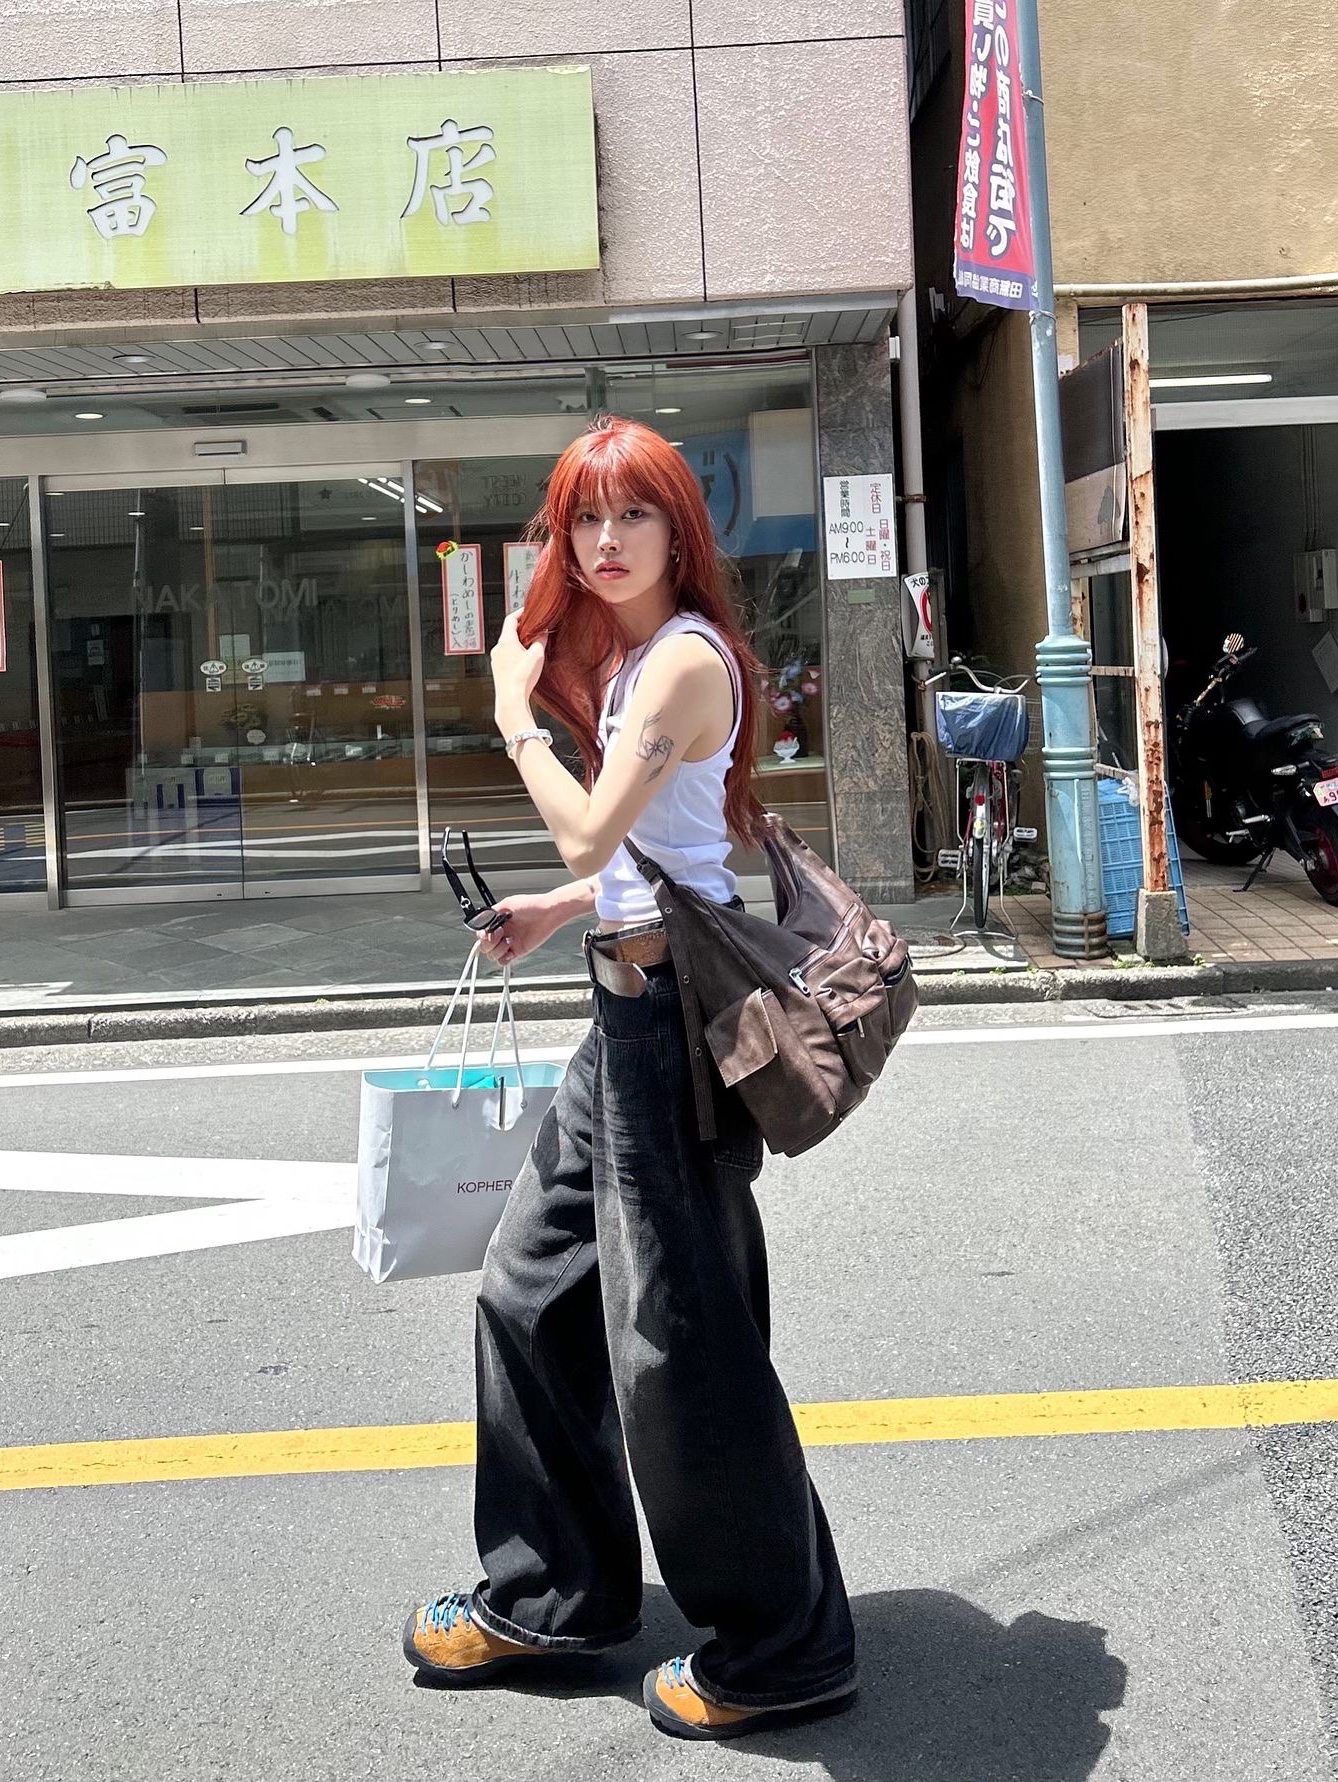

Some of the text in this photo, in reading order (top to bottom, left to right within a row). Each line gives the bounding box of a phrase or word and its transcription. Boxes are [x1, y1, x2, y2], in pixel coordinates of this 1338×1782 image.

[70, 119, 496, 239] 富本店
[840, 480, 850, 518] 営業時間
[870, 482, 881, 514] 定休日
[866, 527, 877, 565] 土曜日
[457, 1179, 513, 1194] KOPHER
